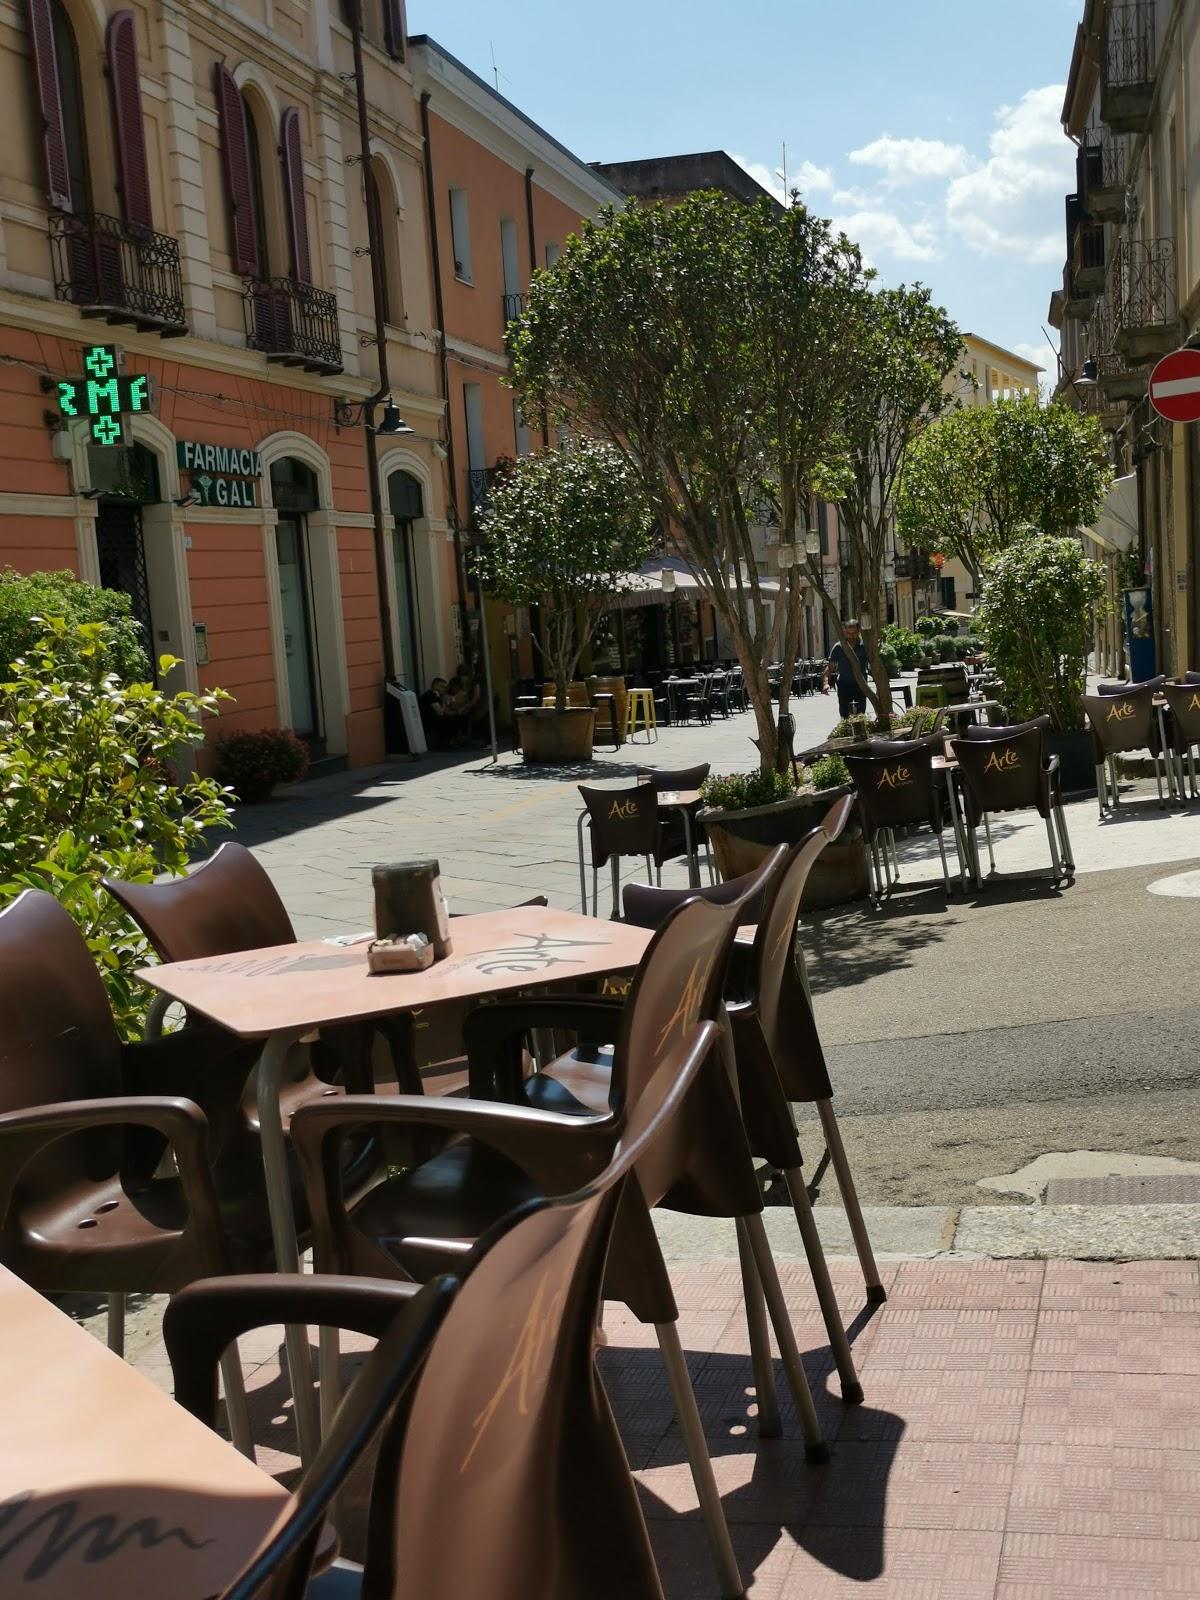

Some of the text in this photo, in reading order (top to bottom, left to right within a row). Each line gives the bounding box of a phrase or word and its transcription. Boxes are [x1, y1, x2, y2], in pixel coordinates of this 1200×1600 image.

[184, 441, 264, 476] FARMACIA
[1106, 702, 1136, 722] Arte
[984, 748, 1019, 774] Arte
[877, 765, 911, 790] Arte
[608, 799, 639, 819] Arte
[465, 932, 612, 976] Arte
